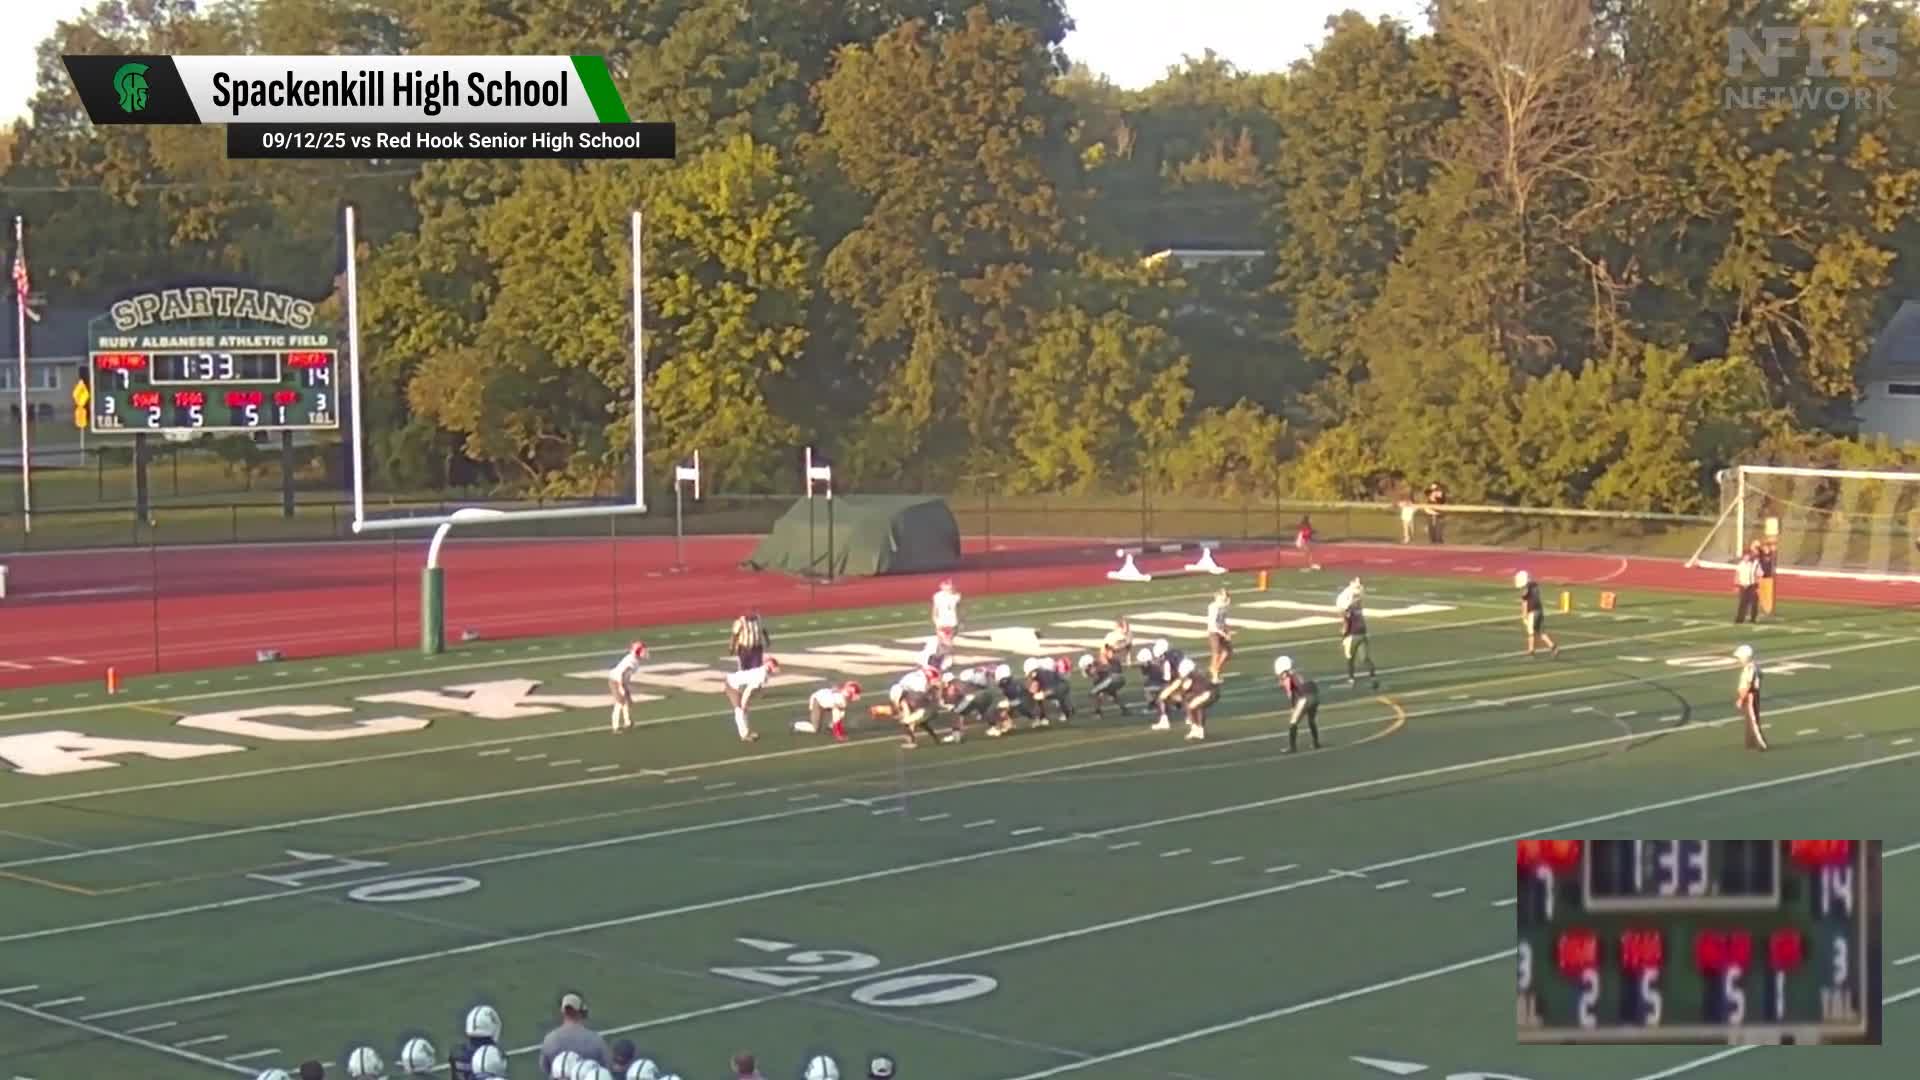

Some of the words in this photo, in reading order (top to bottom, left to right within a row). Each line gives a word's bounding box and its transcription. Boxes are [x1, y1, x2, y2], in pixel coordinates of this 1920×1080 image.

[111, 287, 315, 331] SPARTANS
[218, 335, 285, 347] ATHLETIC
[289, 335, 328, 347] FIELD
[117, 368, 129, 389] 7
[308, 368, 330, 386] 14
[104, 396, 115, 414] 3
[316, 393, 327, 411] 3
[148, 407, 161, 427] 2
[189, 405, 204, 427] 5
[245, 405, 259, 427] 5
[244, 858, 481, 904] 10
[710, 948, 998, 1008] 20
